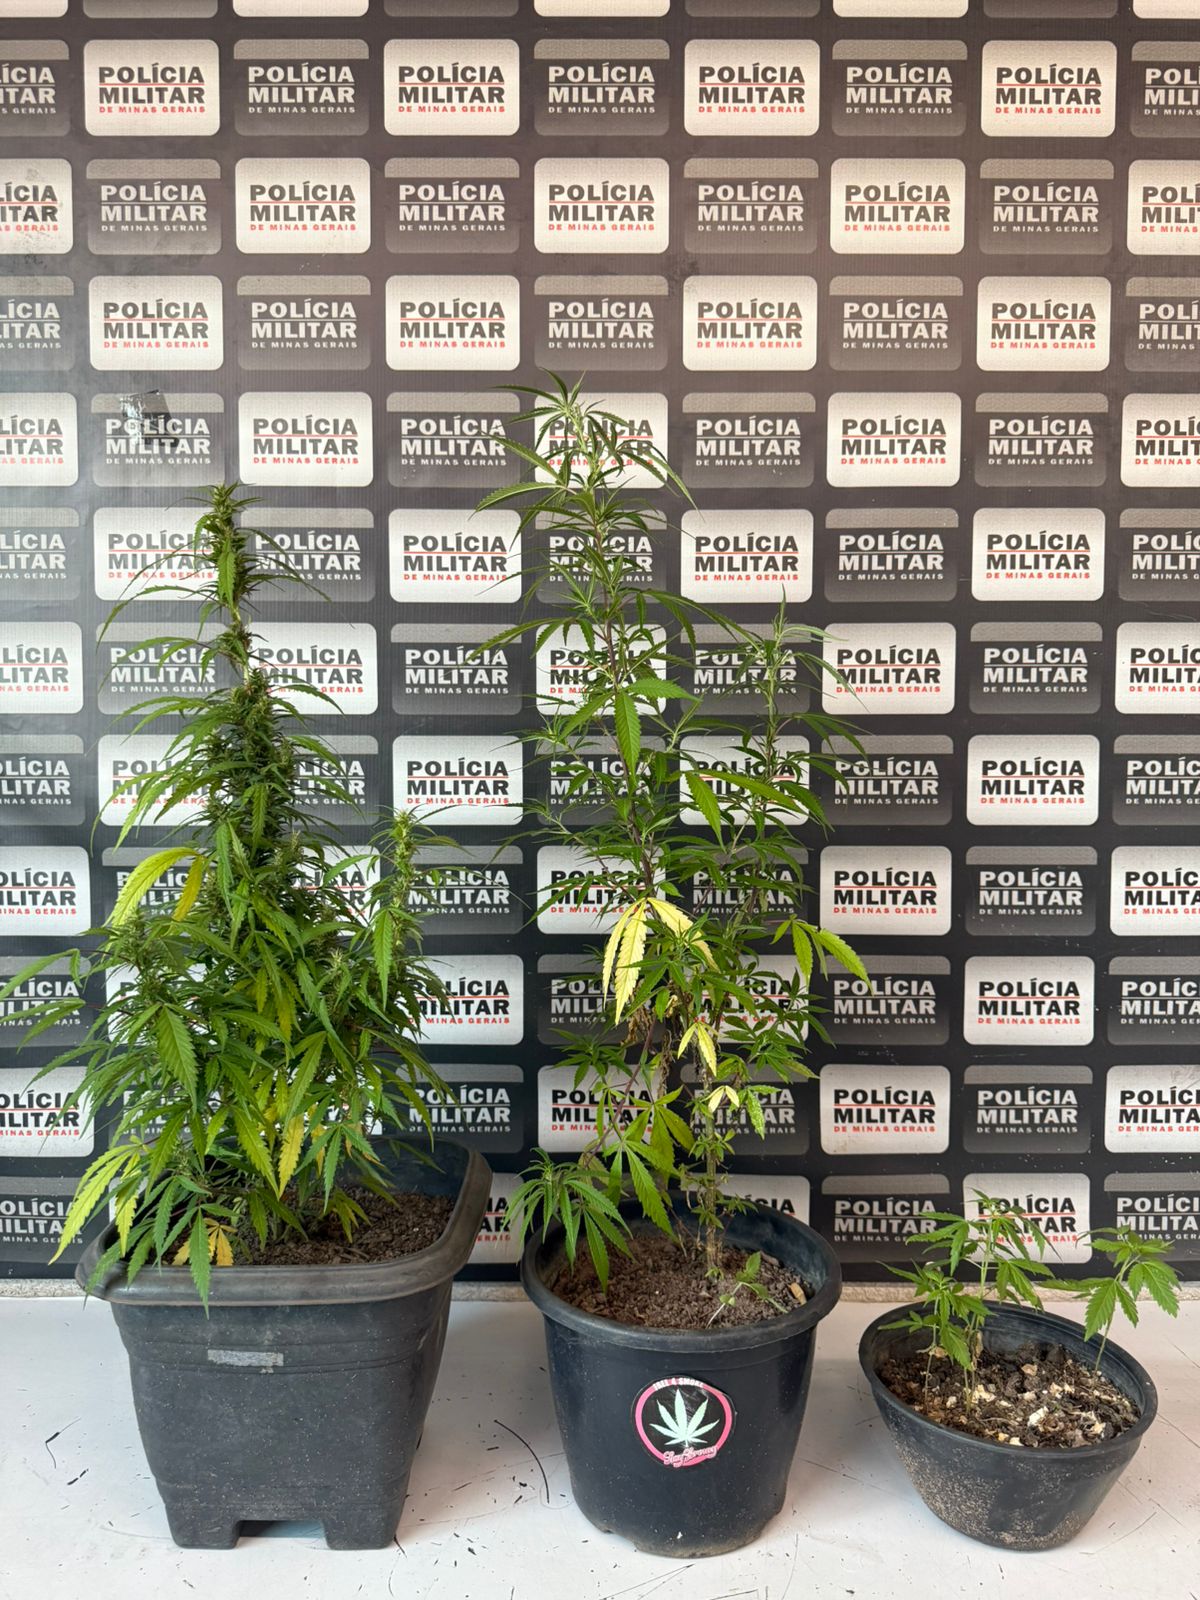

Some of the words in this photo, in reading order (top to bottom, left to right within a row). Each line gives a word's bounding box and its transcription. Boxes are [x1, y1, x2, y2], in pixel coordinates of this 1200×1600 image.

[99, 63, 205, 84] POLÍCIA
[248, 63, 355, 84] POLÍCIA
[548, 63, 655, 85] POLÍCIA
[698, 63, 805, 85] POLÍCIA
[995, 64, 1102, 86] POLÍCIA
[99, 87, 205, 104] MILITAR
[248, 86, 355, 103] MILITAR
[548, 86, 655, 104] MILITAR
[698, 86, 805, 104] MILITAR
[995, 87, 1102, 105] MILITAR
[250, 181, 356, 203] POLÍCIA
[399, 181, 505, 202] POLÍCIA
[844, 181, 951, 202] POLÍCIA
[250, 204, 356, 222] MILITAR
[399, 205, 505, 222] MILITAR
[844, 205, 951, 222] MILITAR
[103, 299, 209, 320] POLÍCIA
[400, 298, 505, 320] POLÍCIA
[697, 299, 803, 320] POLÍCIA
[843, 299, 948, 320] POLÍCIA
[103, 322, 209, 339] MILITAR
[400, 321, 505, 339] MILITAR
[697, 322, 803, 339] MILITAR
[843, 322, 948, 339] MILITAR
[253, 415, 358, 436] POLÍCIA
[696, 416, 801, 437] POLÍCIA
[988, 416, 1094, 436] POLÍCIA
[253, 438, 358, 455] MILITAR
[696, 439, 801, 456] MILITAR
[988, 439, 1094, 455] MILITAR
[256, 530, 361, 551] POLÍCIA
[403, 532, 507, 553] POLÍCIA
[695, 532, 799, 553] POLÍCIA
[838, 531, 944, 552] POLÍCIA
[403, 555, 507, 572] MILITAR
[695, 555, 799, 572] MILITAR
[838, 554, 944, 571] MILITAR
[318, 573, 362, 581] GERAIS
[259, 645, 363, 665] POLÍCIA
[405, 646, 508, 667] POLÍCIA
[983, 644, 1088, 664] POLÍCIA
[405, 668, 508, 685] MILITAR
[983, 667, 1088, 683] MILITAR
[981, 757, 1085, 777] POLÍCIA
[981, 779, 1085, 795] MILITAR
[833, 867, 937, 888] POLÍCIA
[833, 889, 937, 906] MILITAR
[978, 978, 1080, 998] POLÍCIA
[978, 1000, 1080, 1016] MILITAR
[833, 1086, 935, 1106] POLÍCIA
[977, 1087, 1078, 1107] POLÍCIA
[833, 1108, 935, 1124] MILITAR
[977, 1108, 1078, 1124] MILITAR
[834, 1197, 937, 1216] POLÍCIA
[834, 1235, 848, 1243] DE
[853, 1235, 890, 1243] MINAS
